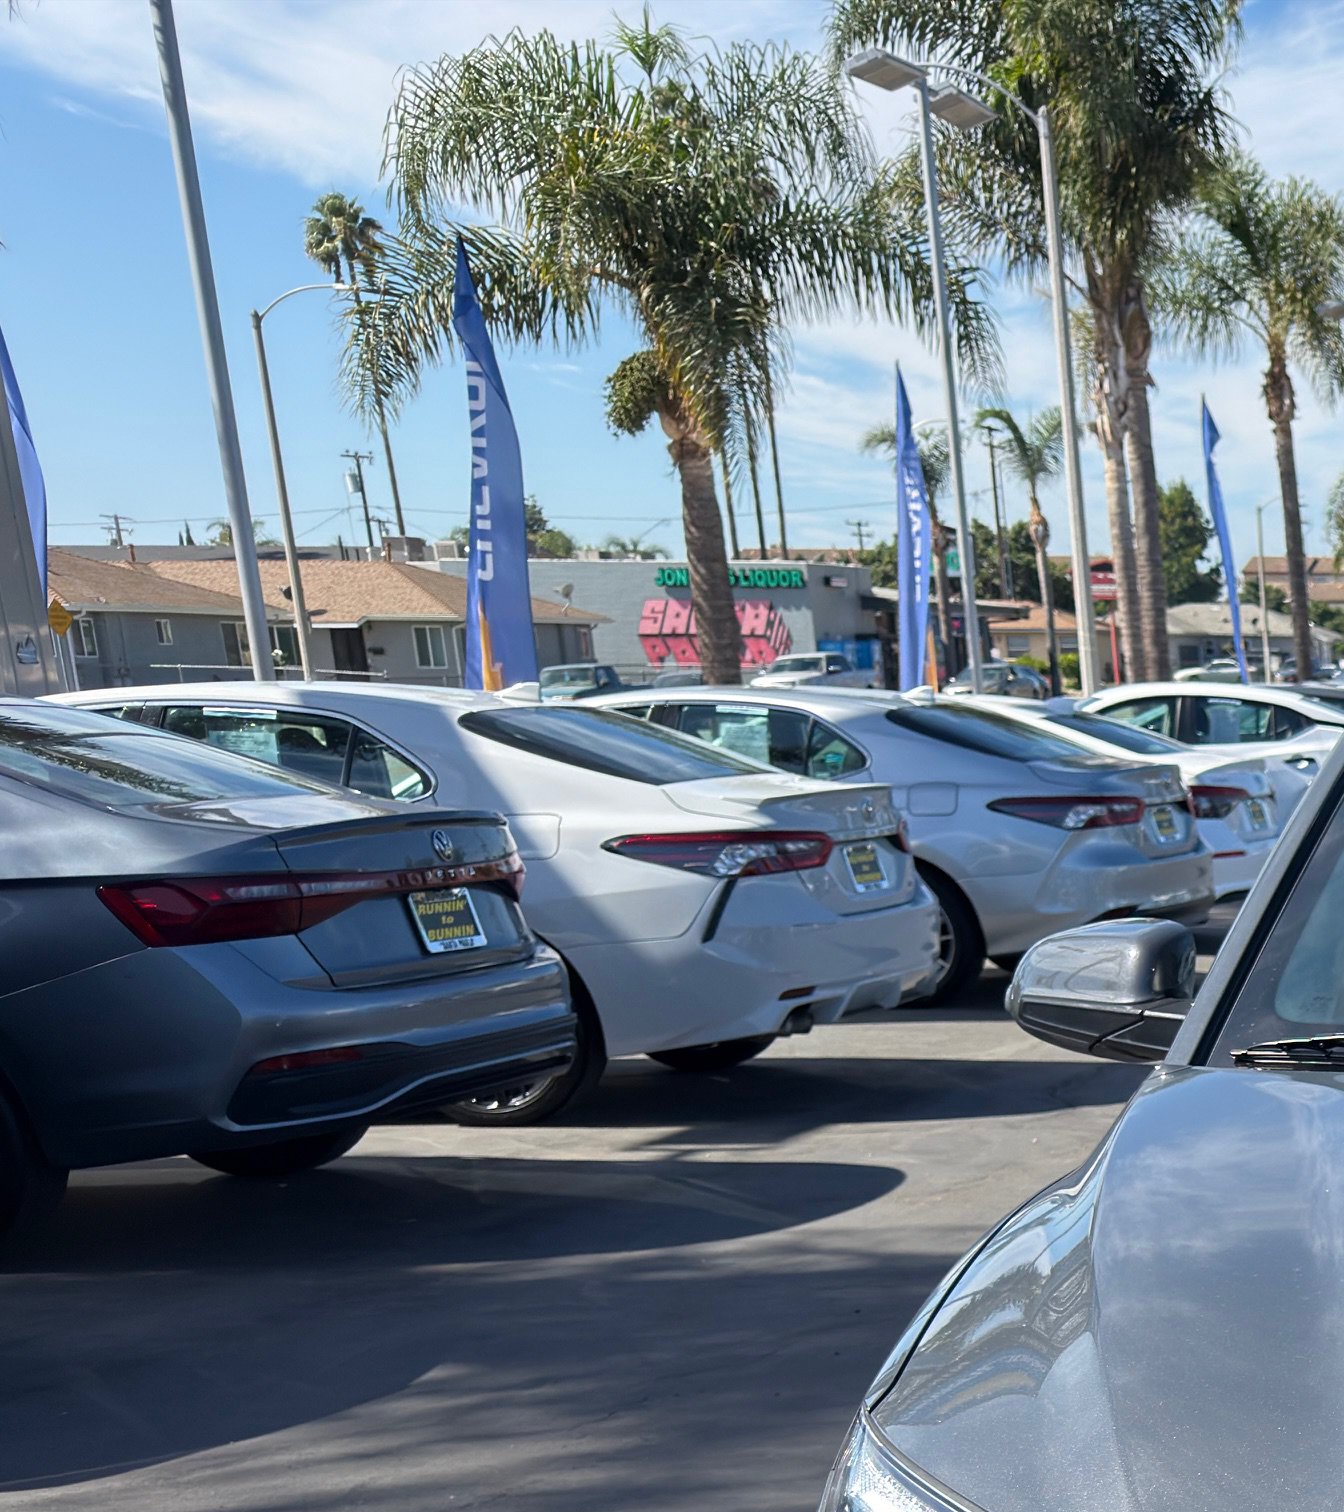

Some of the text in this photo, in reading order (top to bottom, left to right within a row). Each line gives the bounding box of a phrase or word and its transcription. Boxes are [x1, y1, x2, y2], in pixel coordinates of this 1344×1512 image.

[738, 568, 806, 588] LIQUOR
[441, 915, 454, 924] to
[427, 925, 475, 940] BUNNIN
